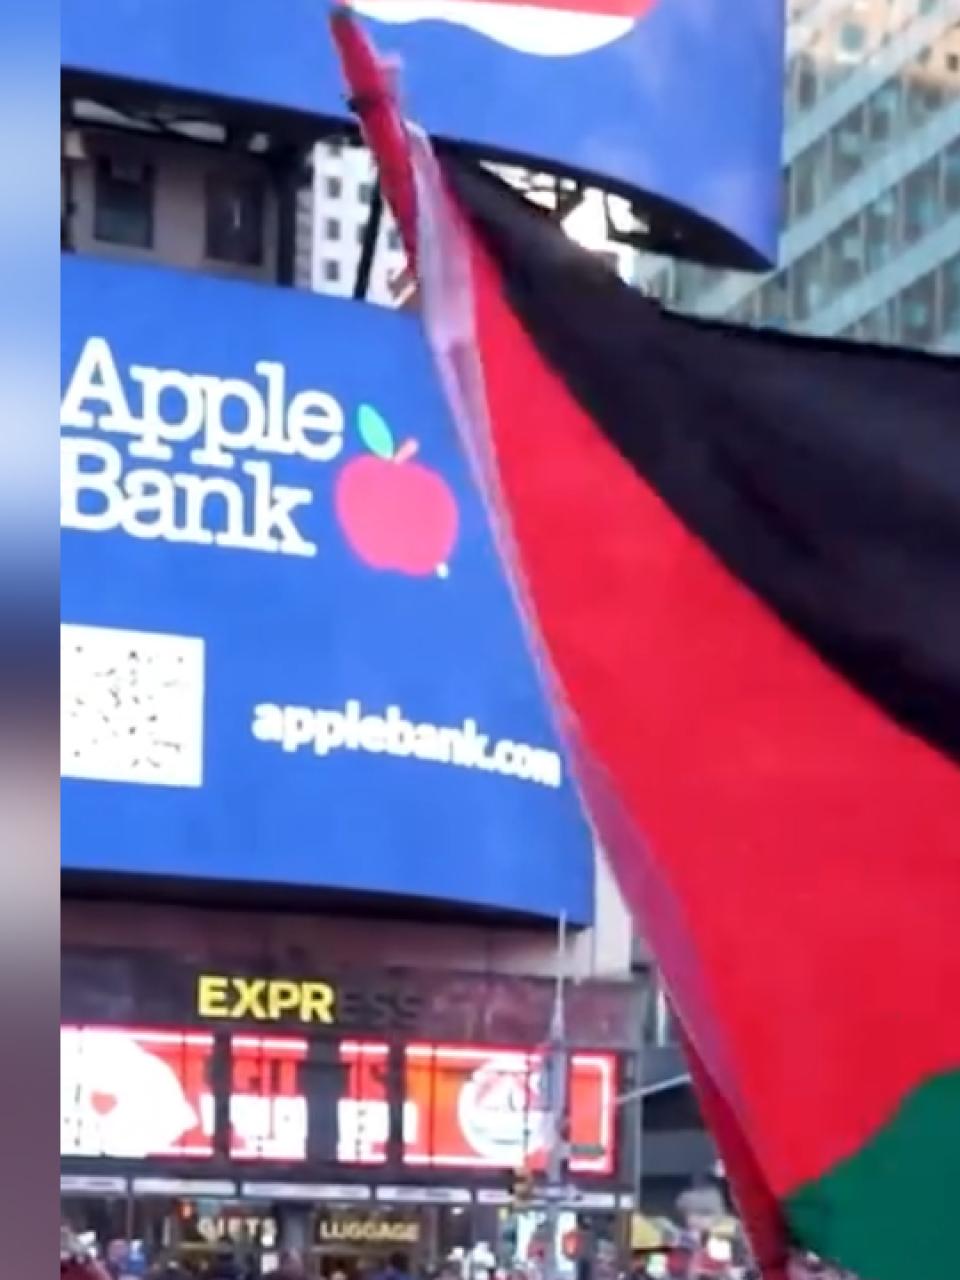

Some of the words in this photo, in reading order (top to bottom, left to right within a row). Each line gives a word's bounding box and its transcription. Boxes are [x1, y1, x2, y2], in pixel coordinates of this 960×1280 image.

[60, 336, 344, 466] Apple
[60, 436, 317, 556] Bank
[251, 699, 561, 788] applebank.com
[319, 1219, 420, 1242] LUGGAGE
